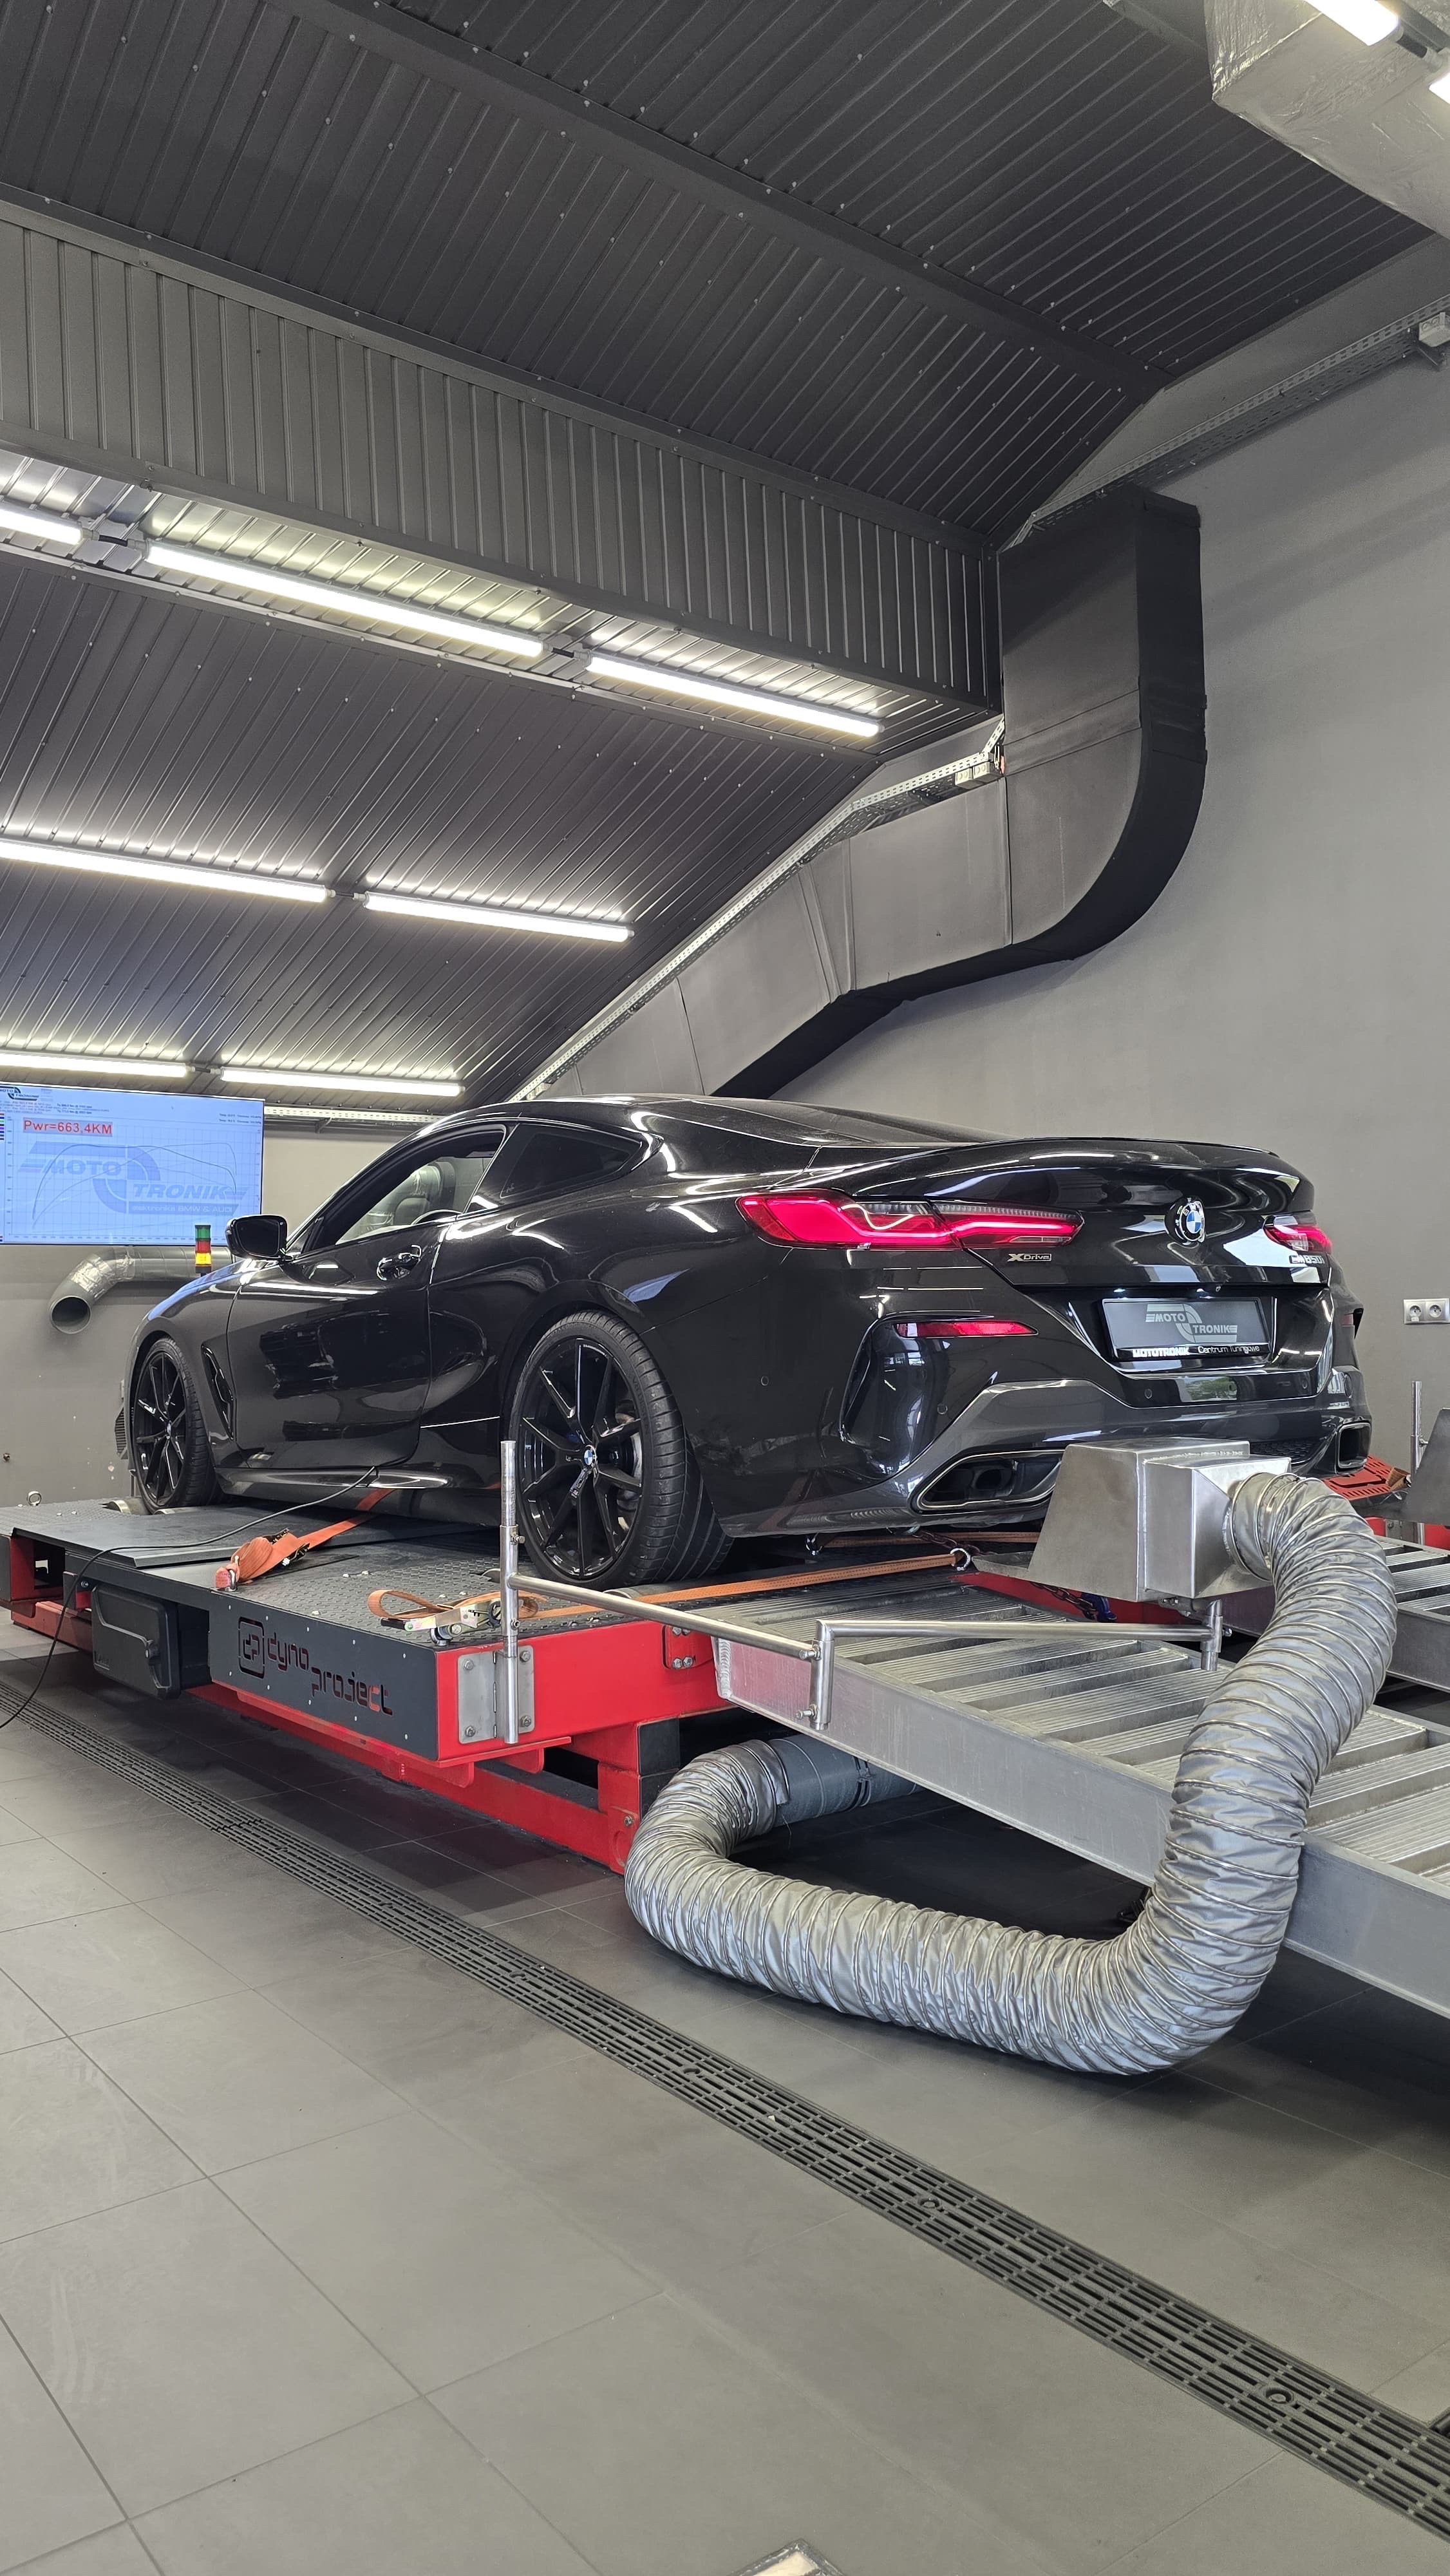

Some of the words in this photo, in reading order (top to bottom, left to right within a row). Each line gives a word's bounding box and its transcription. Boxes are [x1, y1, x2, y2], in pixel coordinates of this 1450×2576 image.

[24, 1120, 112, 1134] Pwr=663,4KM
[42, 1159, 121, 1175] MOTO
[133, 1184, 227, 1200] TRONIK
[1154, 1313, 1185, 1322] MOTO
[1192, 1325, 1231, 1334] TRONIK
[1133, 1347, 1190, 1358] MOTOTRONIK
[1198, 1345, 1229, 1354] Centrum
[267, 1632, 309, 1672] dyno
[311, 1666, 393, 1716] project
